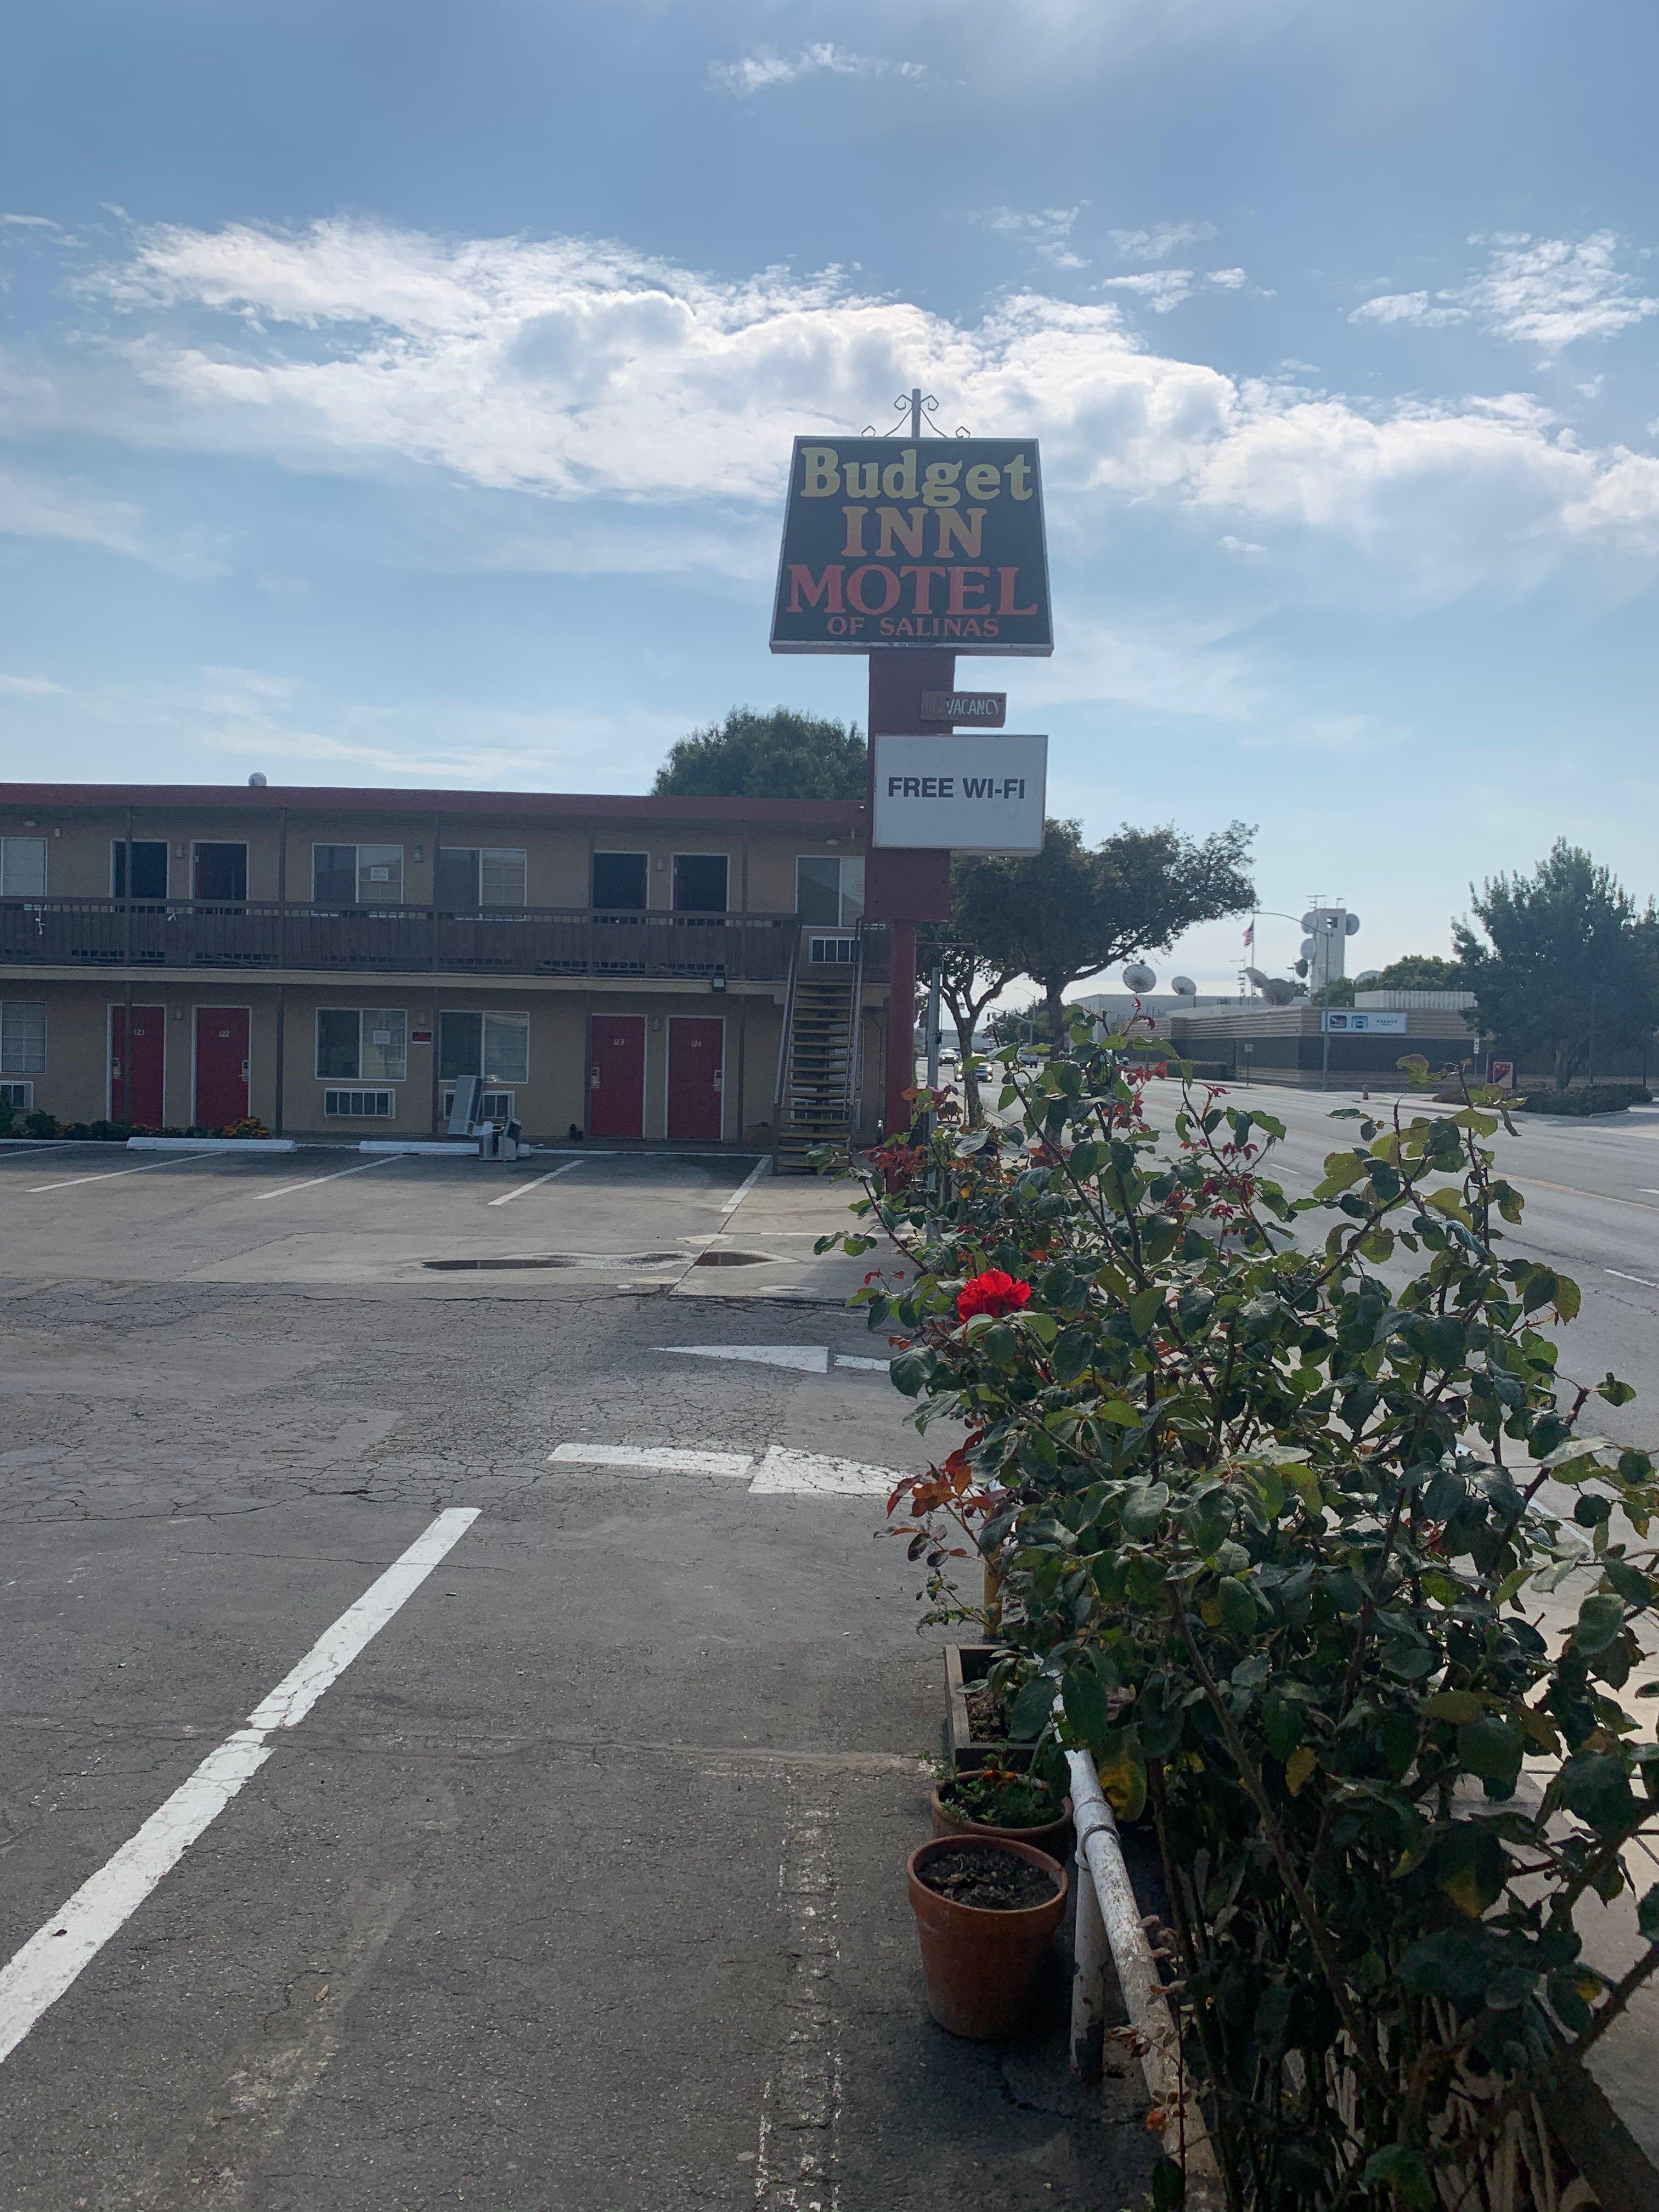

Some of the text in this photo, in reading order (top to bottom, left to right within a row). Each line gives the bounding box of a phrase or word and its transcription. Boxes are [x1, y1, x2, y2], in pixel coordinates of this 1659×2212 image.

[800, 447, 1033, 507] Budget
[840, 505, 988, 558] INN
[786, 564, 1039, 616] MOTEL
[827, 616, 1000, 638] OF SALINAS
[946, 698, 1000, 715] VACANCY
[888, 777, 1026, 799] FREE WI-FI
